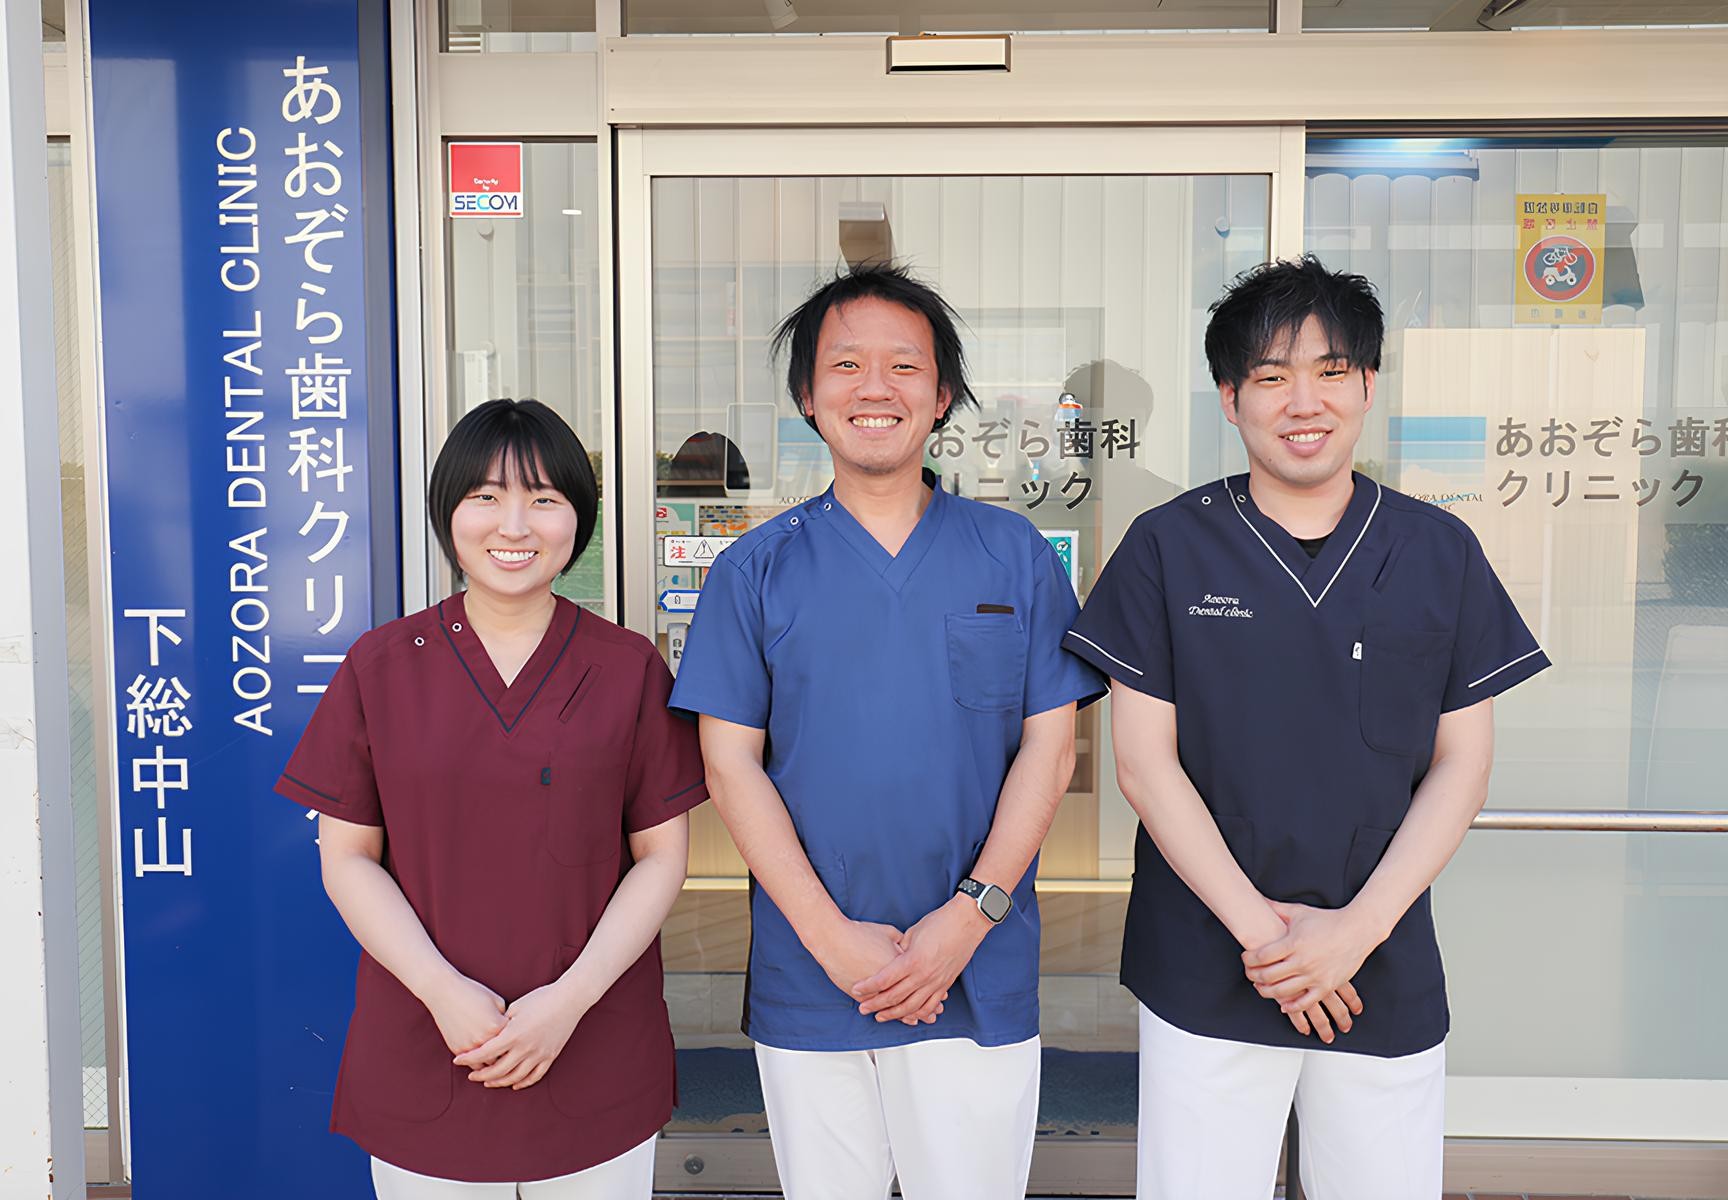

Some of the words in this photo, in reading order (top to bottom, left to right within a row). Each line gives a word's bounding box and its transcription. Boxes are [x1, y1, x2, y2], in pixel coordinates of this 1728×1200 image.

[216, 126, 261, 293] CLINIC
[454, 194, 518, 211] SECOM
[222, 310, 267, 508] DENTAL
[281, 56, 353, 846] あおぞら歯科クリニ
[1497, 469, 1703, 507] クリニック
[230, 527, 273, 737] AOZORA
[124, 609, 192, 877] 下総中山
